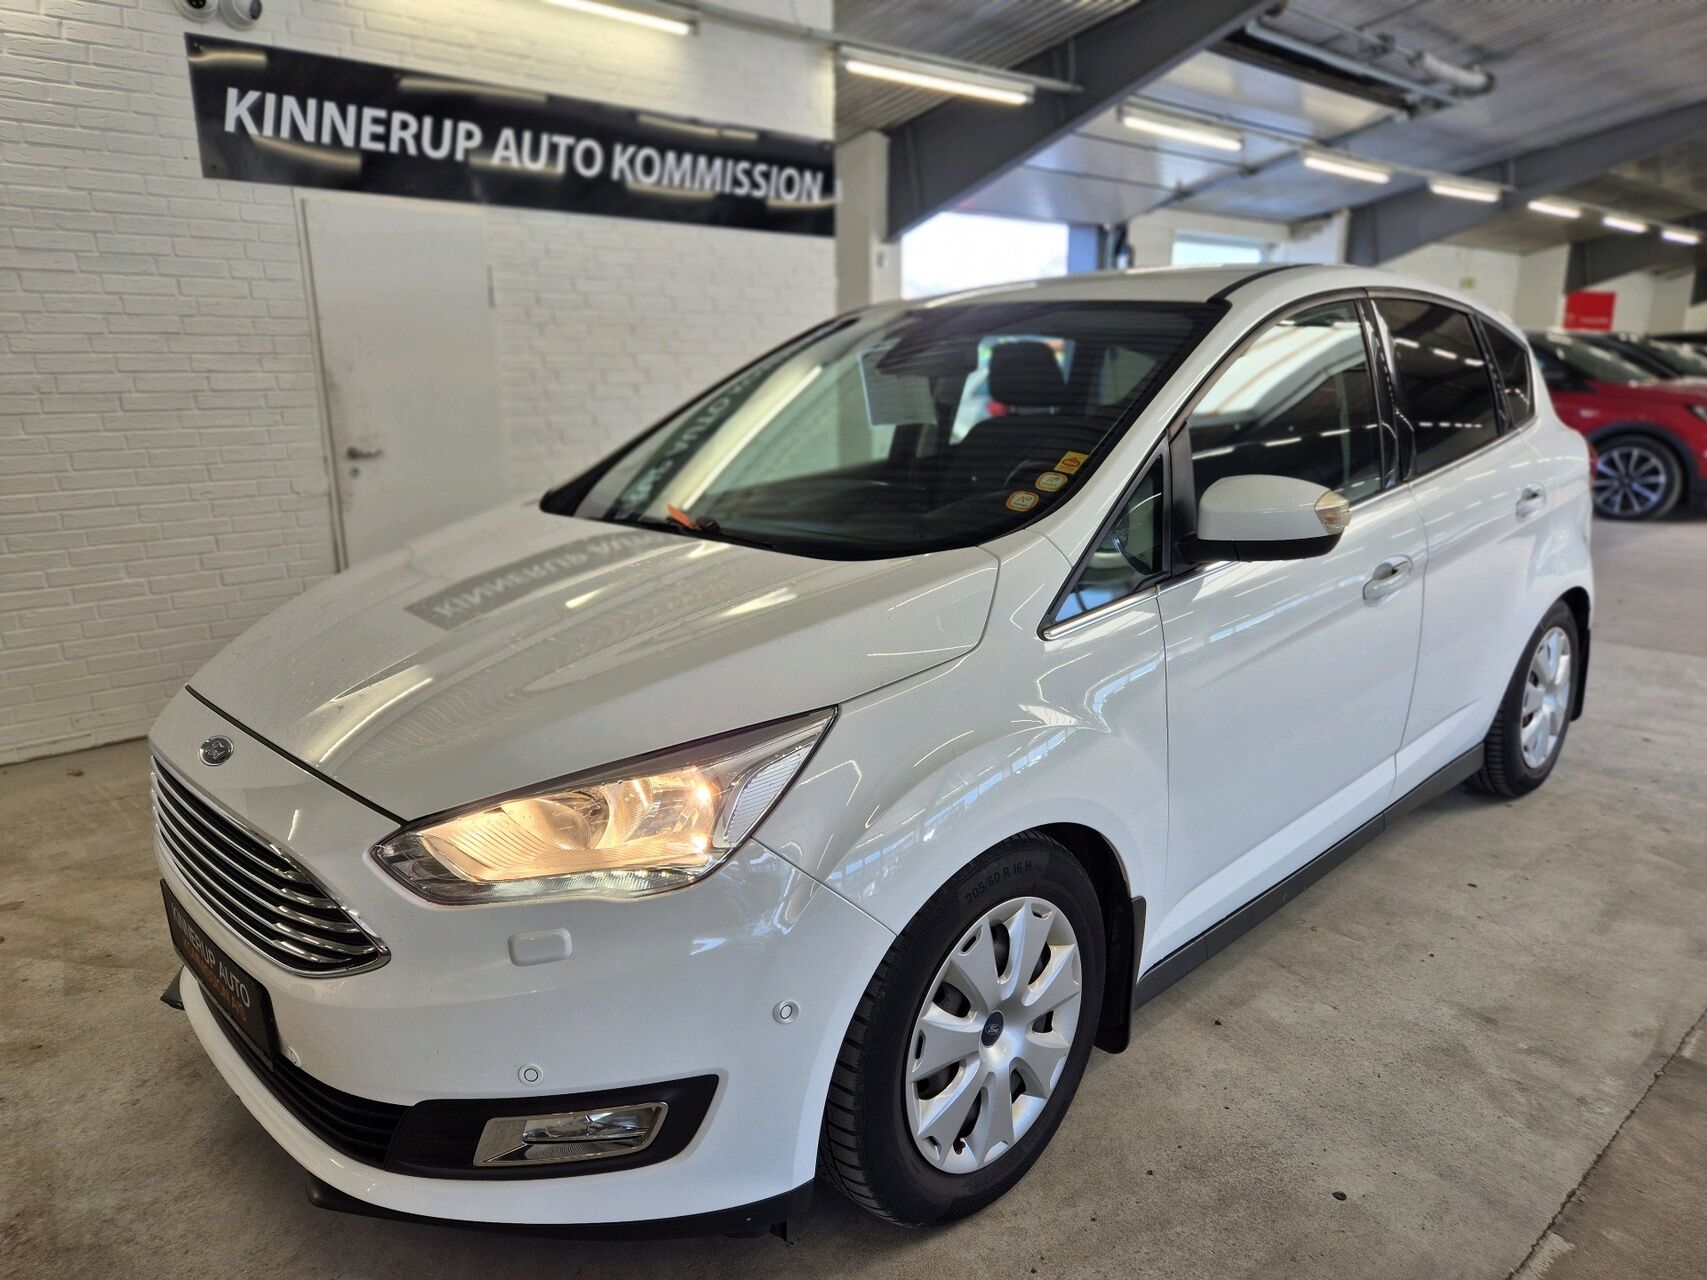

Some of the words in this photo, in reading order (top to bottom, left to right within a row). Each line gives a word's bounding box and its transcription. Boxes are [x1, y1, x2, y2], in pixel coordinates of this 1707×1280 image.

[224, 87, 483, 162] KINNERUP
[491, 127, 604, 178] AUTO
[611, 143, 824, 204] KOMMISSION
[965, 873, 1000, 903] 205/60
[1013, 863, 1022, 875] 16
[218, 961, 251, 1008] AUTO
